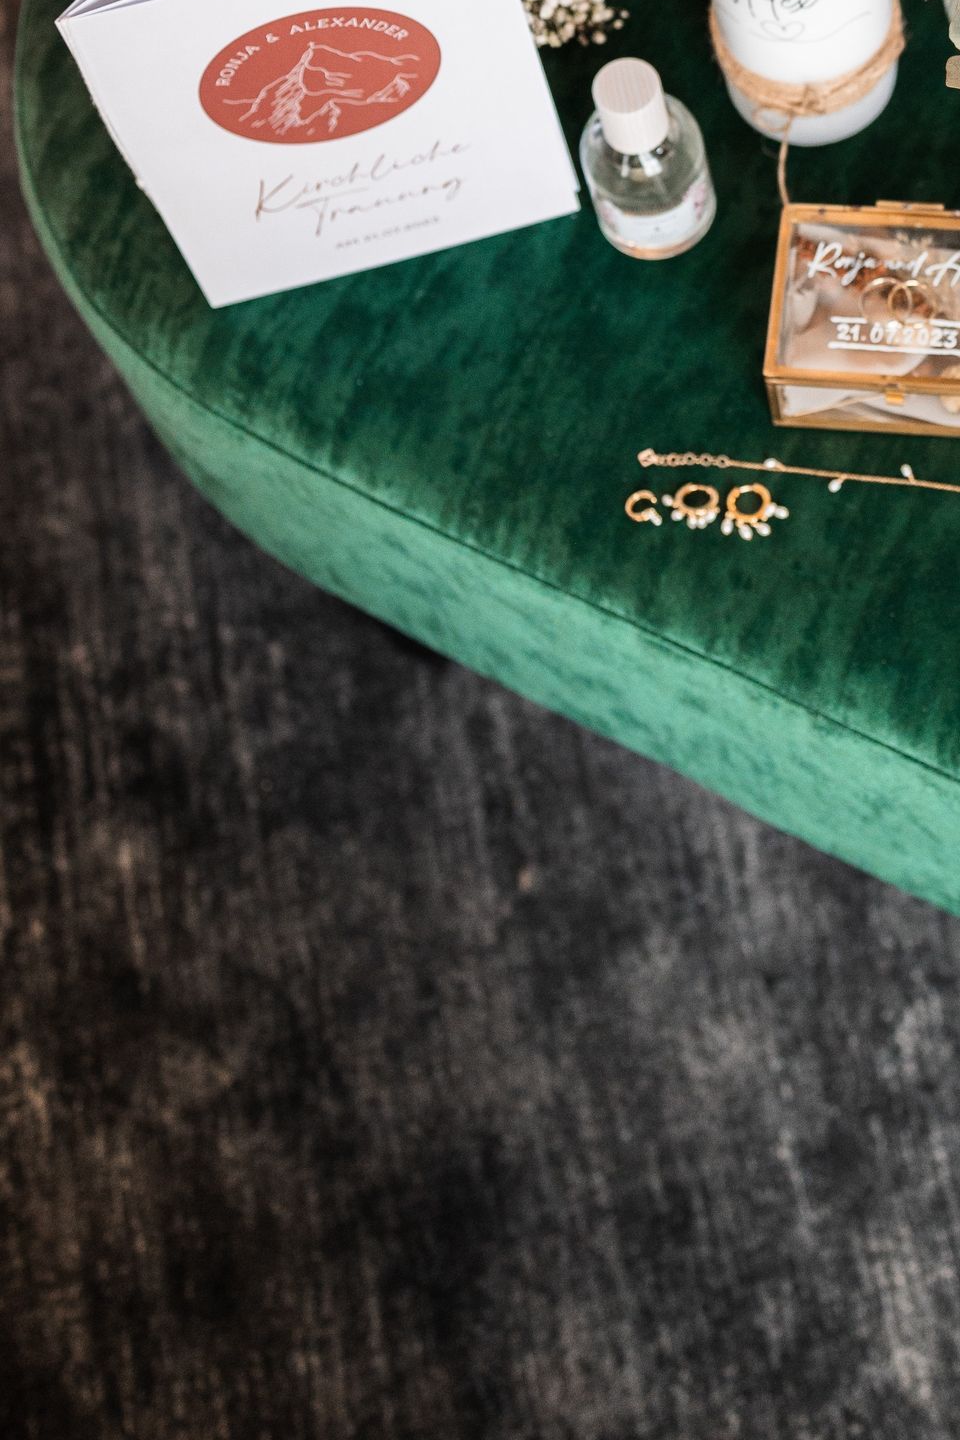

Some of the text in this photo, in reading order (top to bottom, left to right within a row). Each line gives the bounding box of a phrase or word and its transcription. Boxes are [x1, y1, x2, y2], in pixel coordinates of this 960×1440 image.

[215, 44, 261, 88] RONJA
[289, 17, 410, 41] ALEXANDER
[255, 139, 472, 223] Kirchliche
[807, 241, 877, 287] Ronja
[884, 250, 929, 278] und
